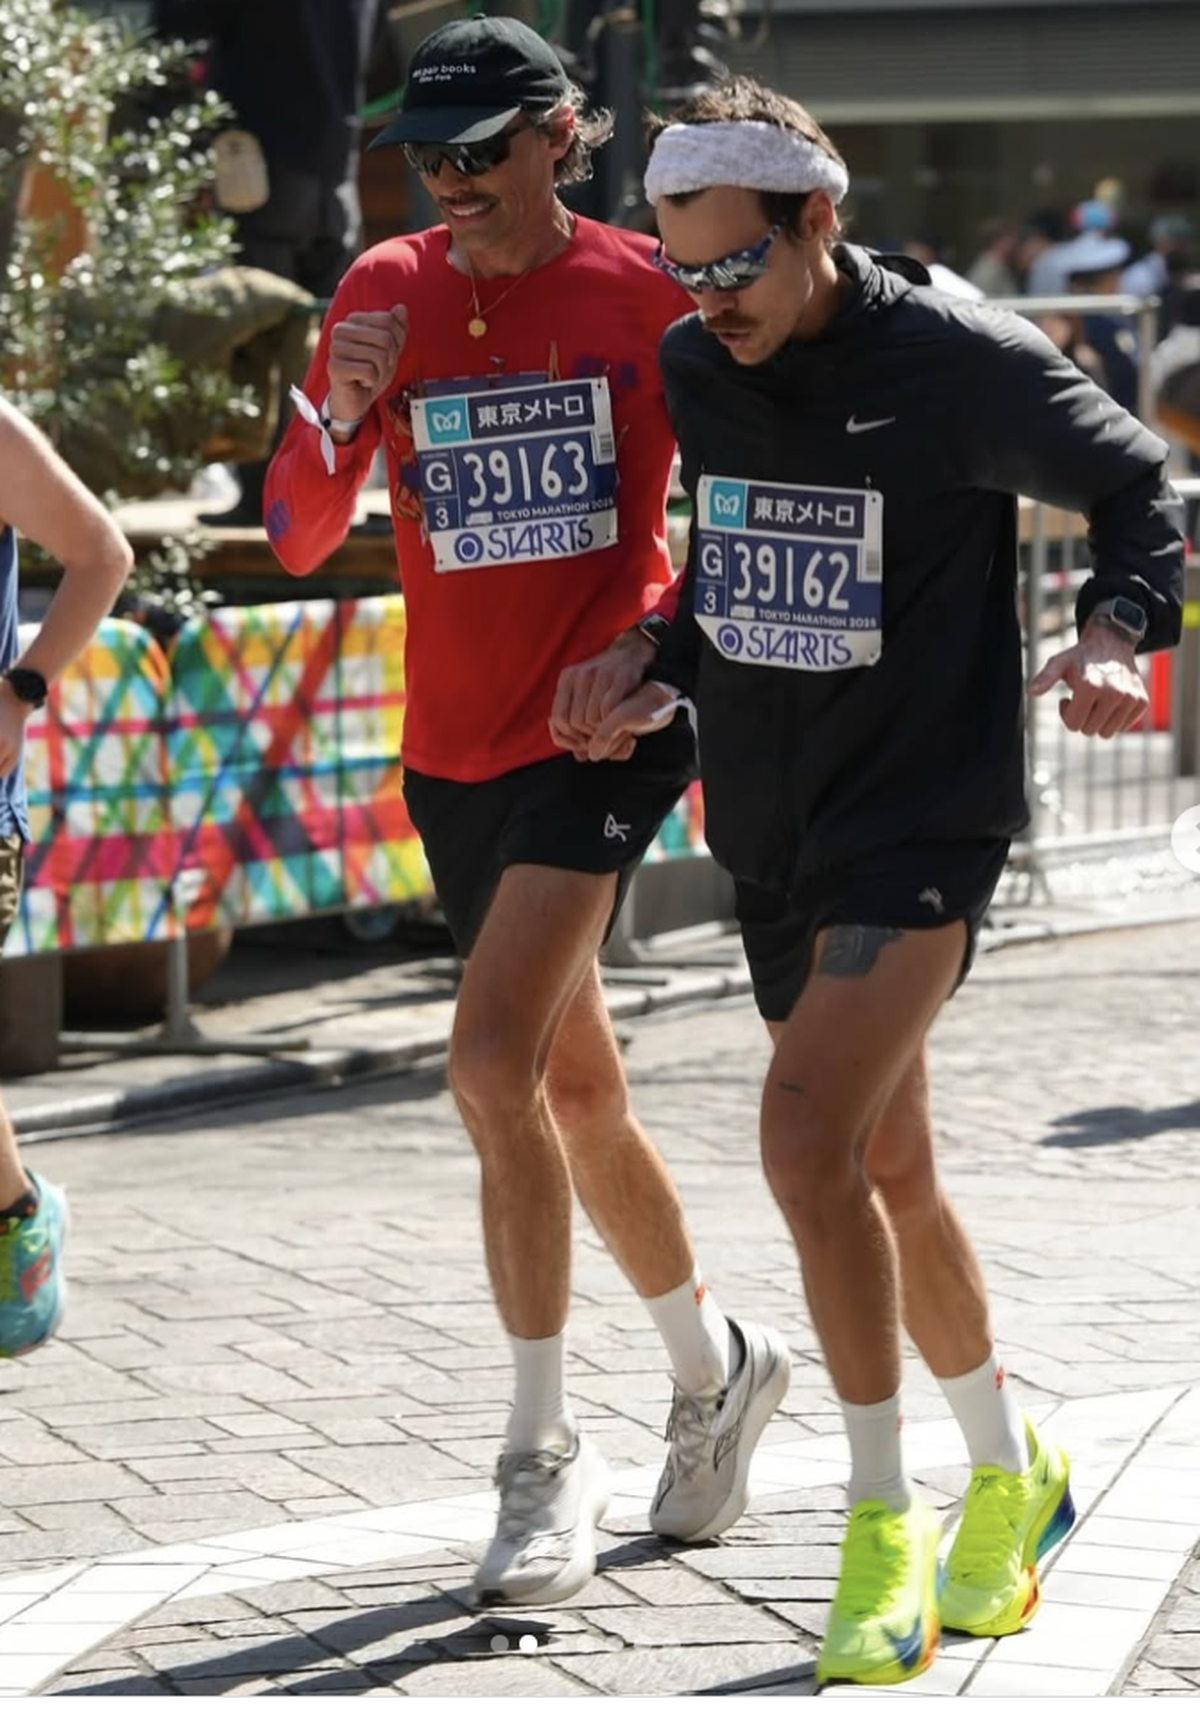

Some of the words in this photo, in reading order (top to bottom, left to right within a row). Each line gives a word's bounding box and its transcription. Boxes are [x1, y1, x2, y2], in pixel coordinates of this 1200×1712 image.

[441, 63, 476, 73] books
[477, 396, 584, 428] 東京メトロ
[425, 461, 452, 493] G
[463, 441, 588, 507] 39163
[435, 507, 449, 528] 3
[497, 509, 529, 520] TOKYO
[532, 502, 590, 516] MARATHON
[753, 497, 855, 527] 東京メトロ
[701, 542, 723, 577] G
[733, 542, 849, 610] 39162
[704, 591, 716, 614] 3
[759, 609, 790, 621] TOKYO
[792, 612, 847, 627] MARATHON
[849, 617, 876, 628] 2025
